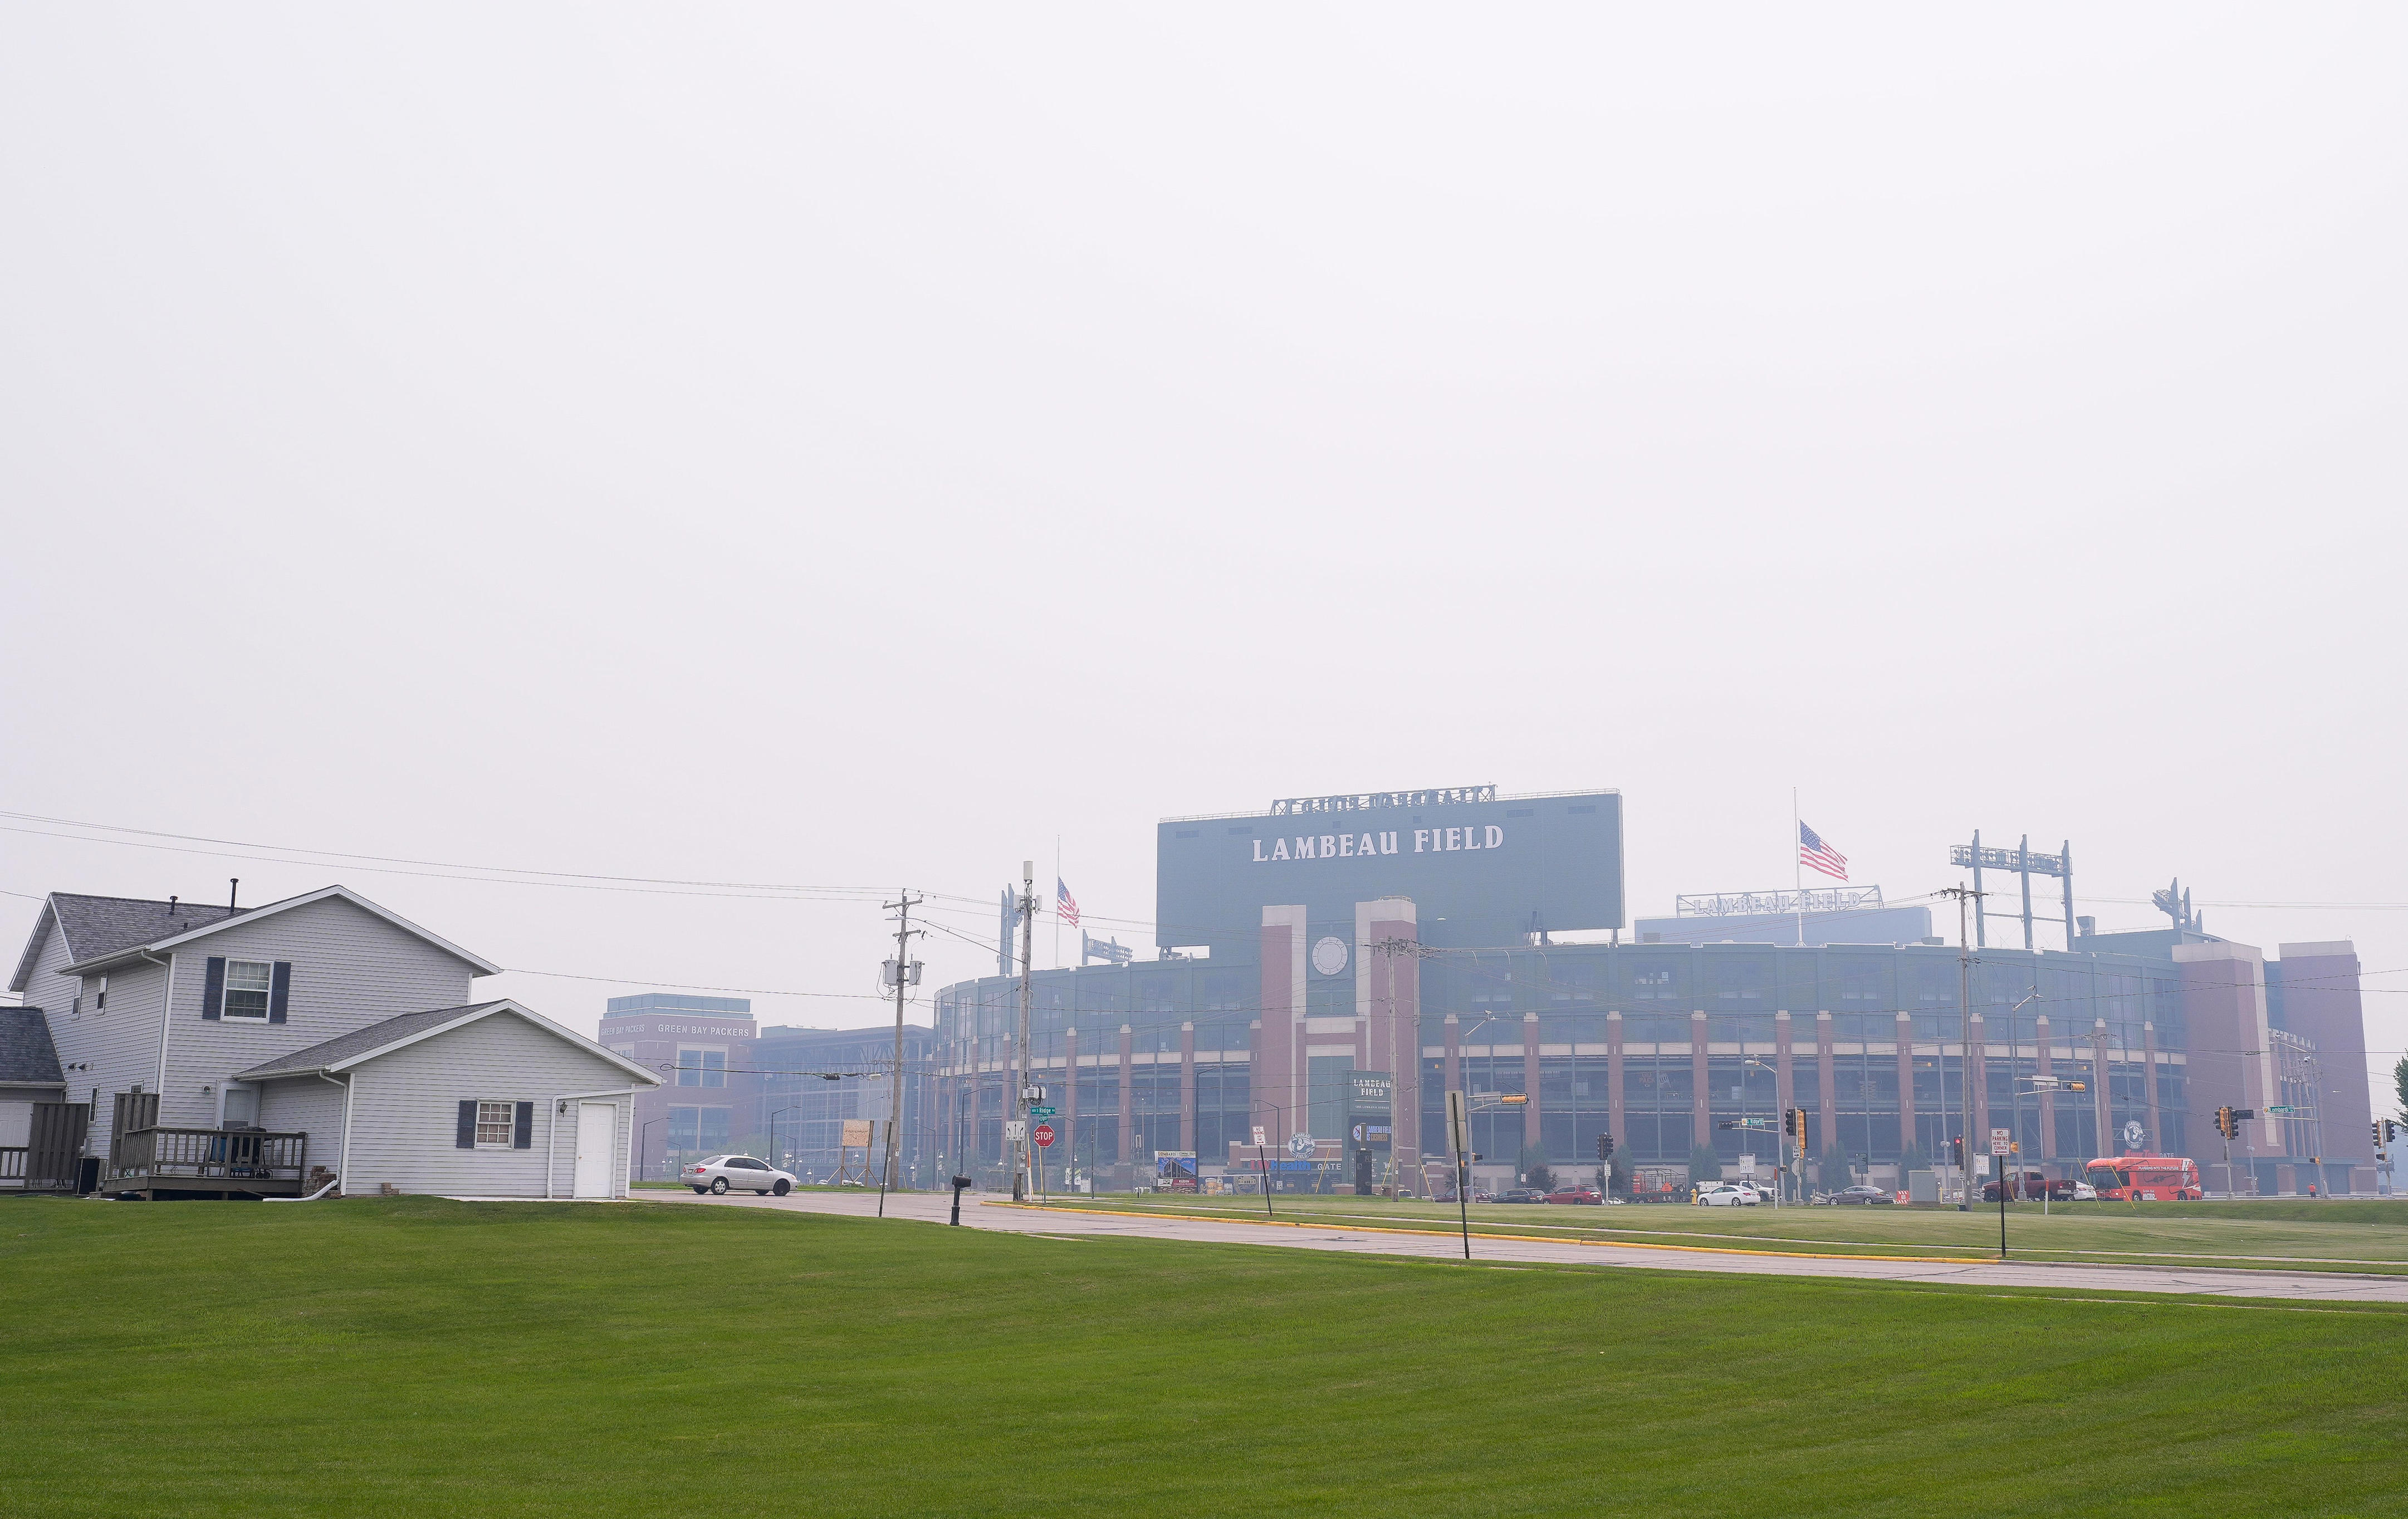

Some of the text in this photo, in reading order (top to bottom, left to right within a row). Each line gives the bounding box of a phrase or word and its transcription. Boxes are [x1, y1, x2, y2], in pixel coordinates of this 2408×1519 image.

[1252, 825, 1504, 862] LAMBEAU FIELD
[1694, 892, 1861, 914] LAMBEAU FIELD
[601, 1025, 645, 1036] GREEN BAY PACKERS
[658, 1025, 750, 1036] GREEN BAY PACKERS
[1354, 1079, 1391, 1088] LAMBEAU
[1361, 1088, 1383, 1096] FIELD
[1035, 1132, 1053, 1140] STOP
